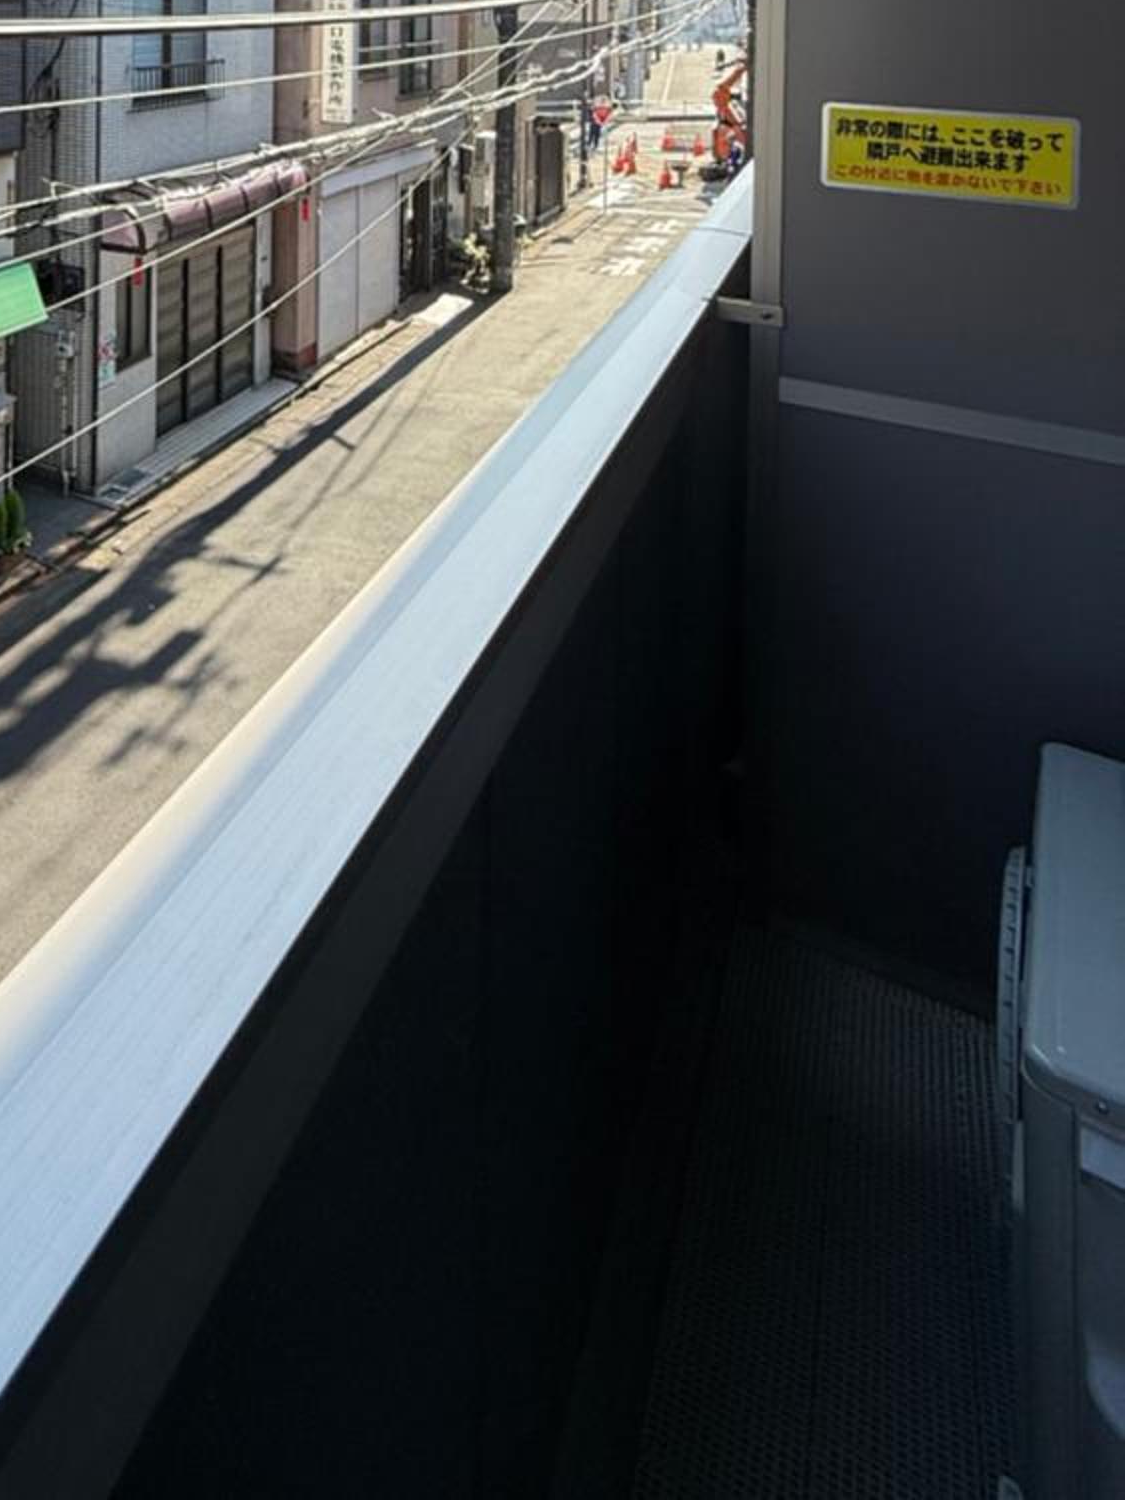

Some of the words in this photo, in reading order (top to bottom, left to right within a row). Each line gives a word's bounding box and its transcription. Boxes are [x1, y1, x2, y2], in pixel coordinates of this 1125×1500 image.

[835, 117, 1065, 153] 非常の際には、ここを破って
[867, 141, 1031, 173] 隣戸へ避難出来ます
[835, 163, 1062, 196] この付近に物を置かないで下さい
